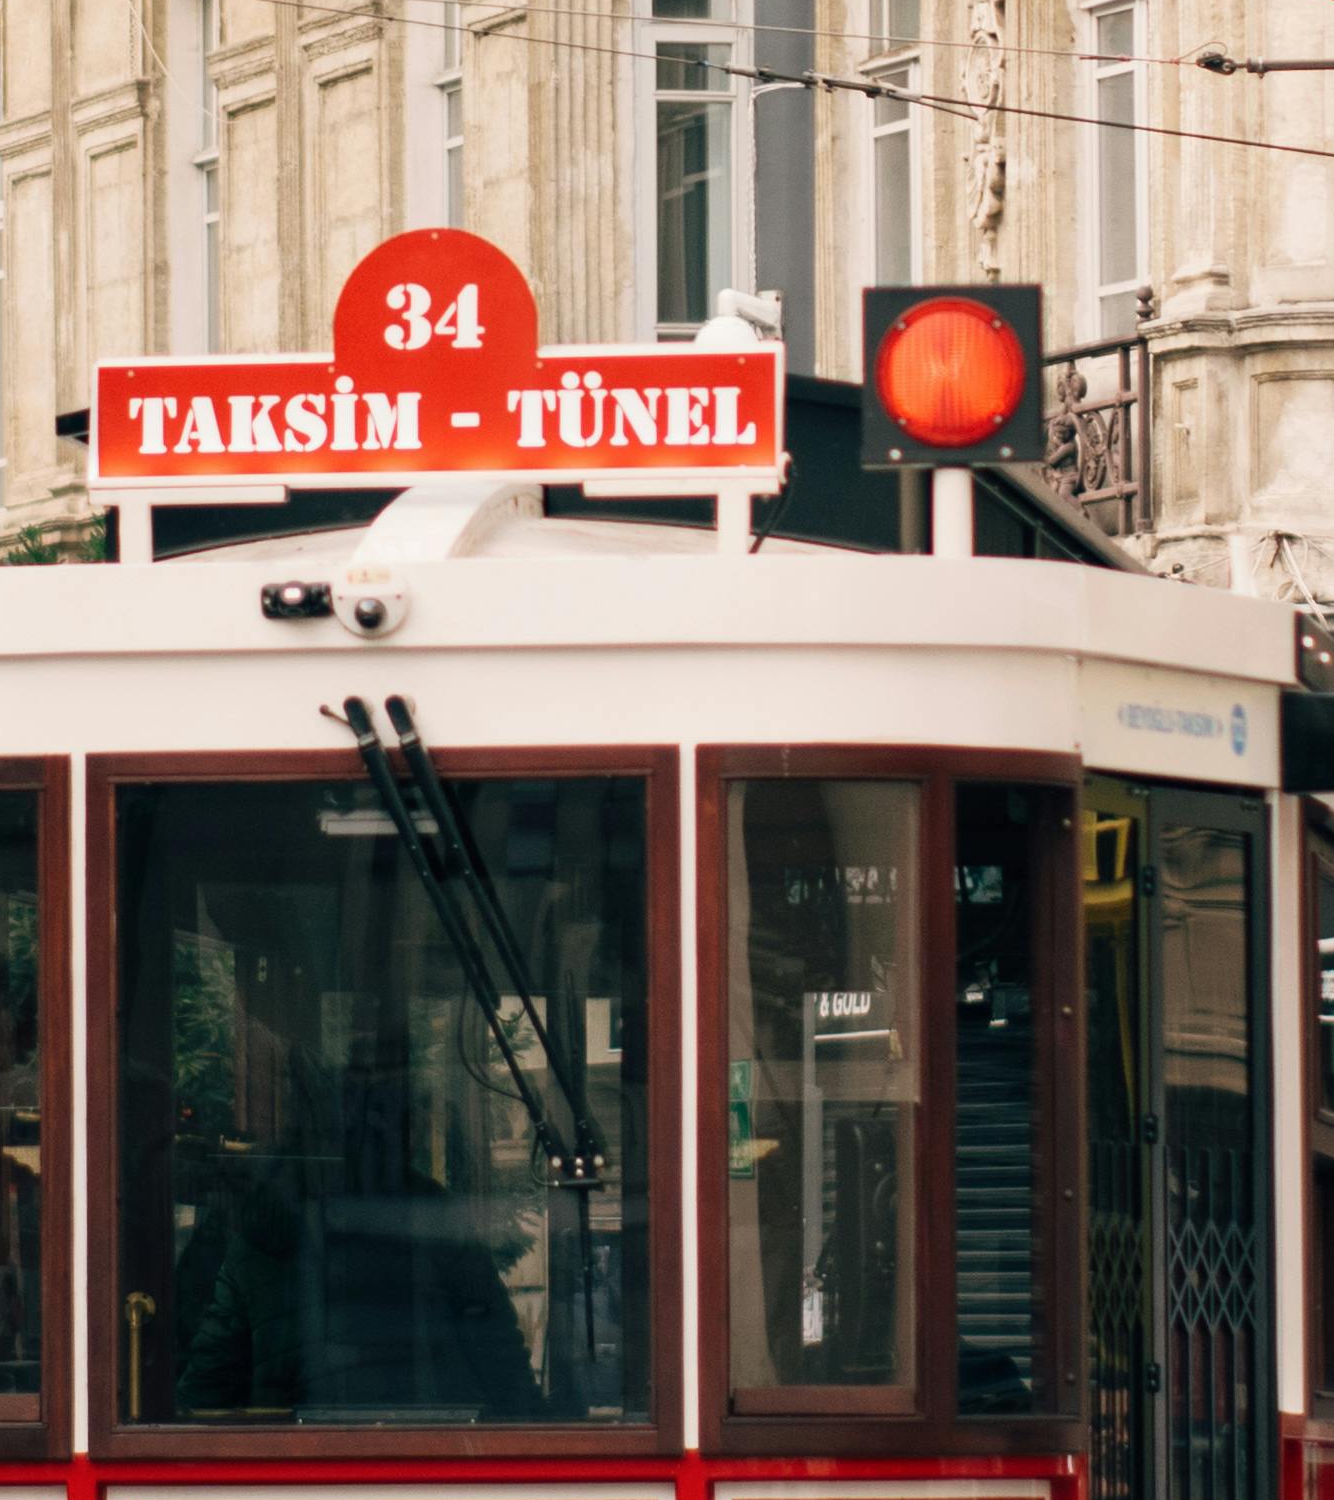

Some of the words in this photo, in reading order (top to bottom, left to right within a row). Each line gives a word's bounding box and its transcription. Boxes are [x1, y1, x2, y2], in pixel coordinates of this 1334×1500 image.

[384, 283, 485, 350] 34
[129, 375, 422, 453] TAKSİM
[451, 412, 481, 428] -
[507, 371, 756, 448] TÜNEL
